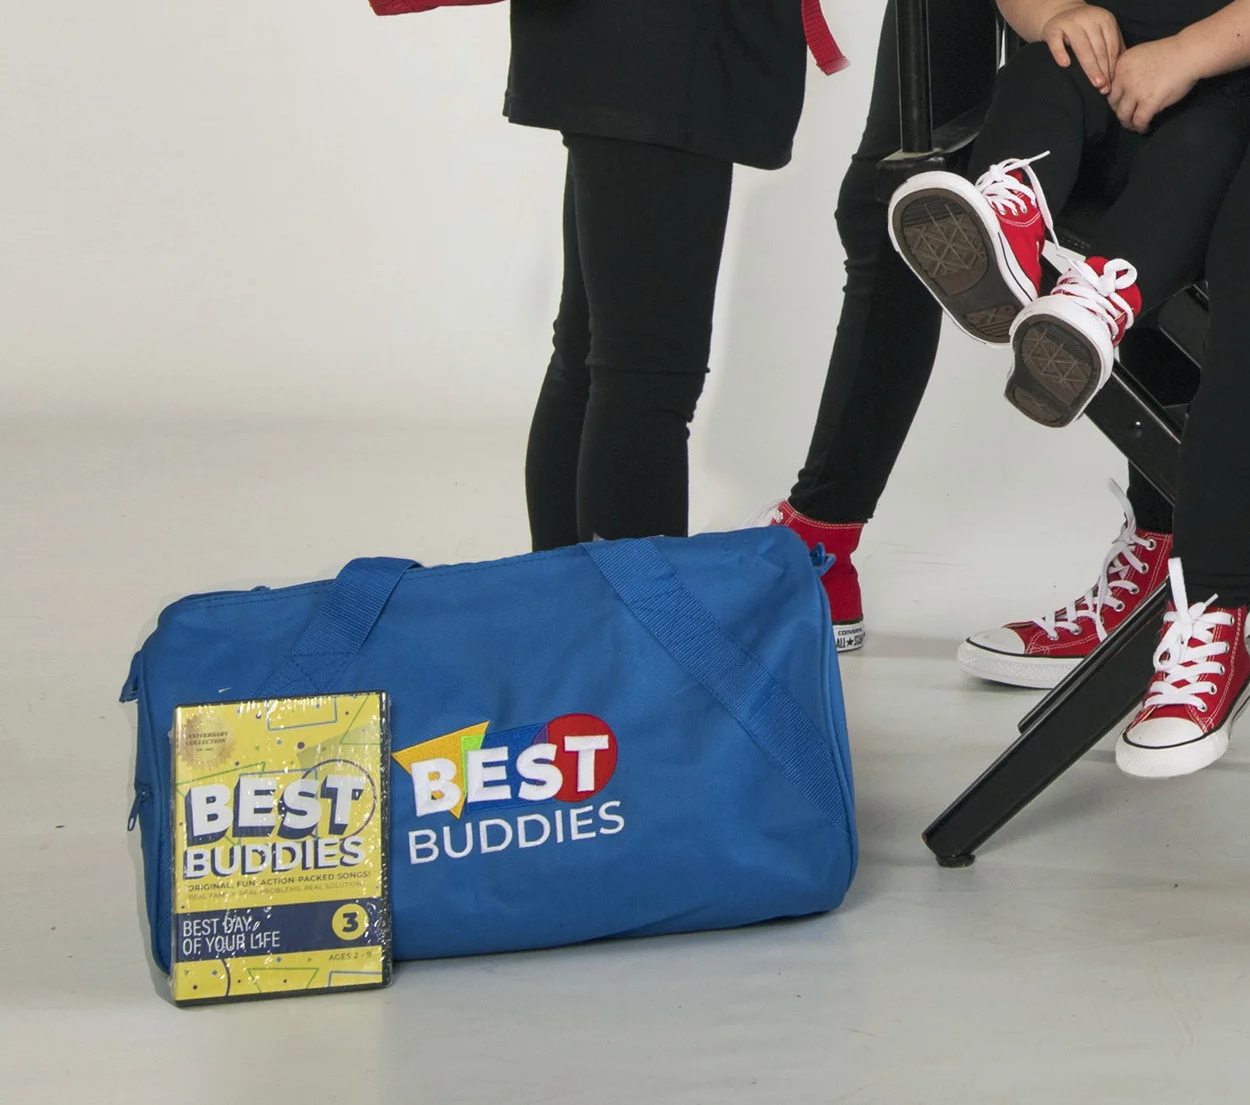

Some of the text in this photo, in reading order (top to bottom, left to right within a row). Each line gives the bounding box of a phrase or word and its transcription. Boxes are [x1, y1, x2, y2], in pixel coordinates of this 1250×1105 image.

[410, 734, 609, 817] BEST
[186, 774, 365, 844] BEST
[408, 800, 625, 865] BUDDIES
[183, 836, 366, 880] BUDDIES
[337, 870, 371, 880] SONGS!
[183, 915, 252, 937] BEST DAY
[342, 911, 359, 933] 3
[182, 930, 280, 956] OF YOUR LIFE
[328, 952, 351, 961] AGES
